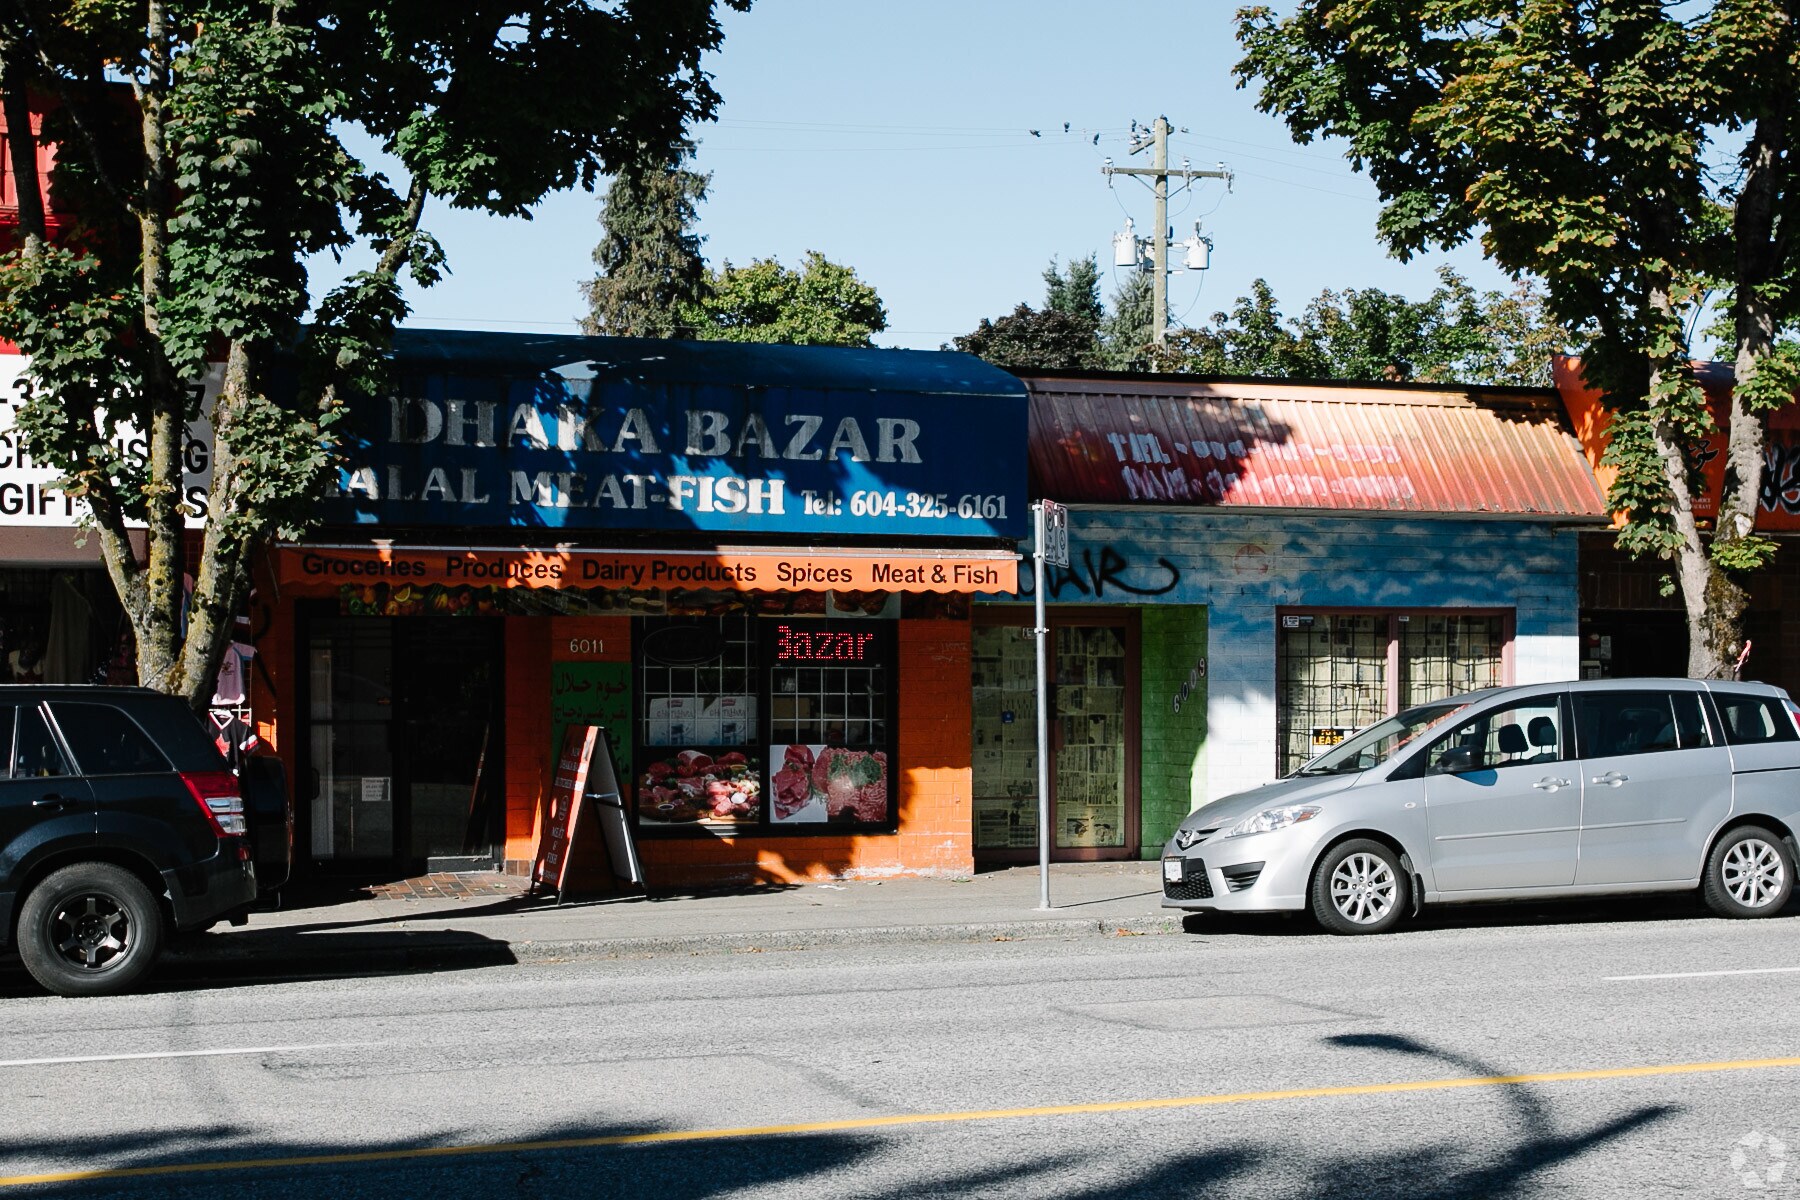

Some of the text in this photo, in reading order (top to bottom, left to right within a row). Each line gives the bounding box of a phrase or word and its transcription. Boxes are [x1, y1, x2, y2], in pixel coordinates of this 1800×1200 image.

[389, 396, 923, 464] DHAKA BAZAR
[801, 490, 842, 516] Tel:
[850, 490, 1008, 519] 604-325-6161
[302, 554, 998, 587] Groceries Produces Dairy Products Spices Meat & Fish
[570, 638, 604, 654] 6011
